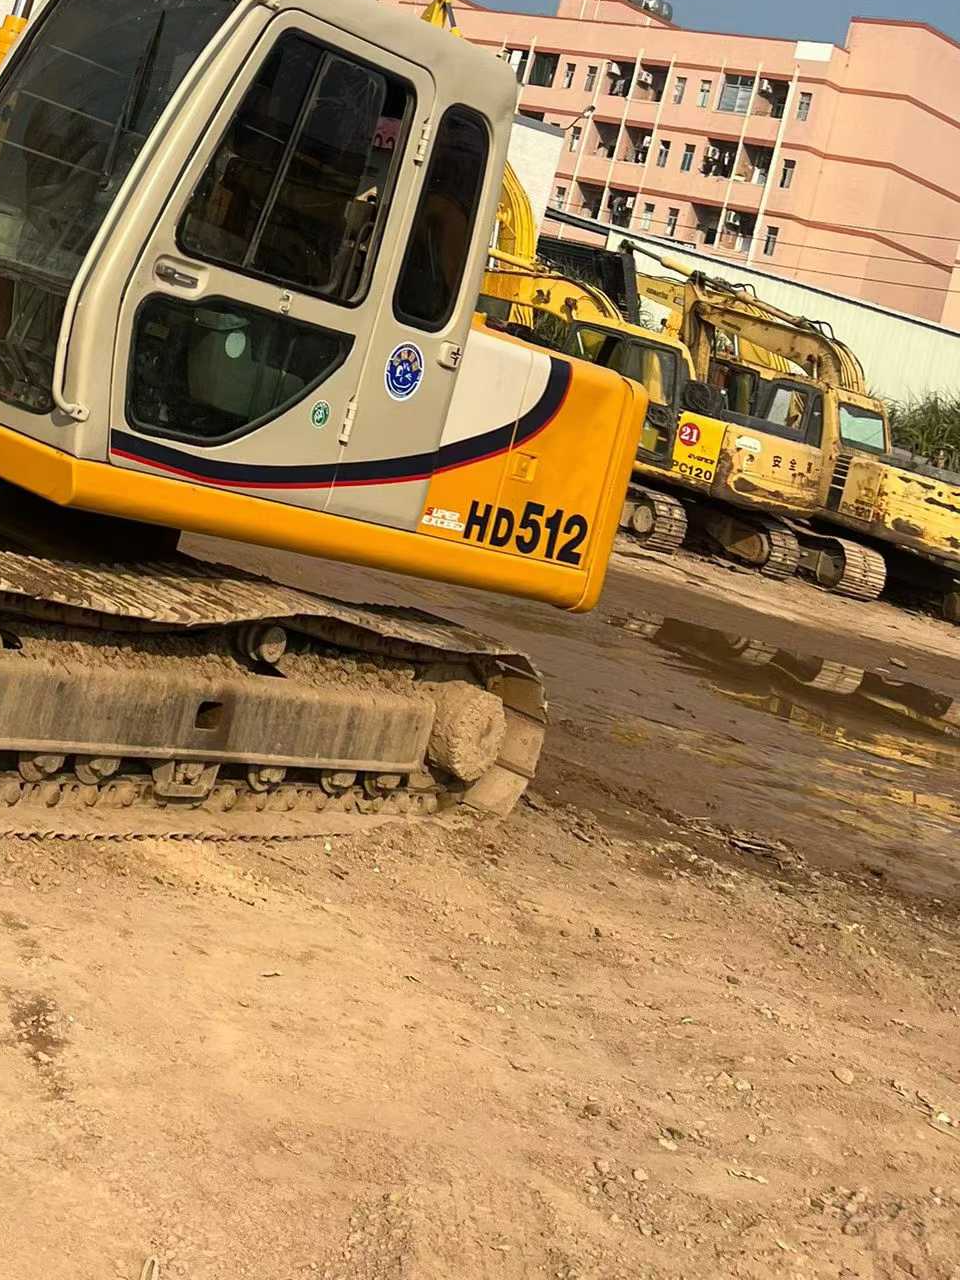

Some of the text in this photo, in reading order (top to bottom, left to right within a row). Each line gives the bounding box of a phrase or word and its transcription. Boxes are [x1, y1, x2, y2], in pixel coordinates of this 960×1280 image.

[680, 424, 698, 443] 21
[424, 506, 461, 522] SUPER
[463, 499, 588, 566] HD512
